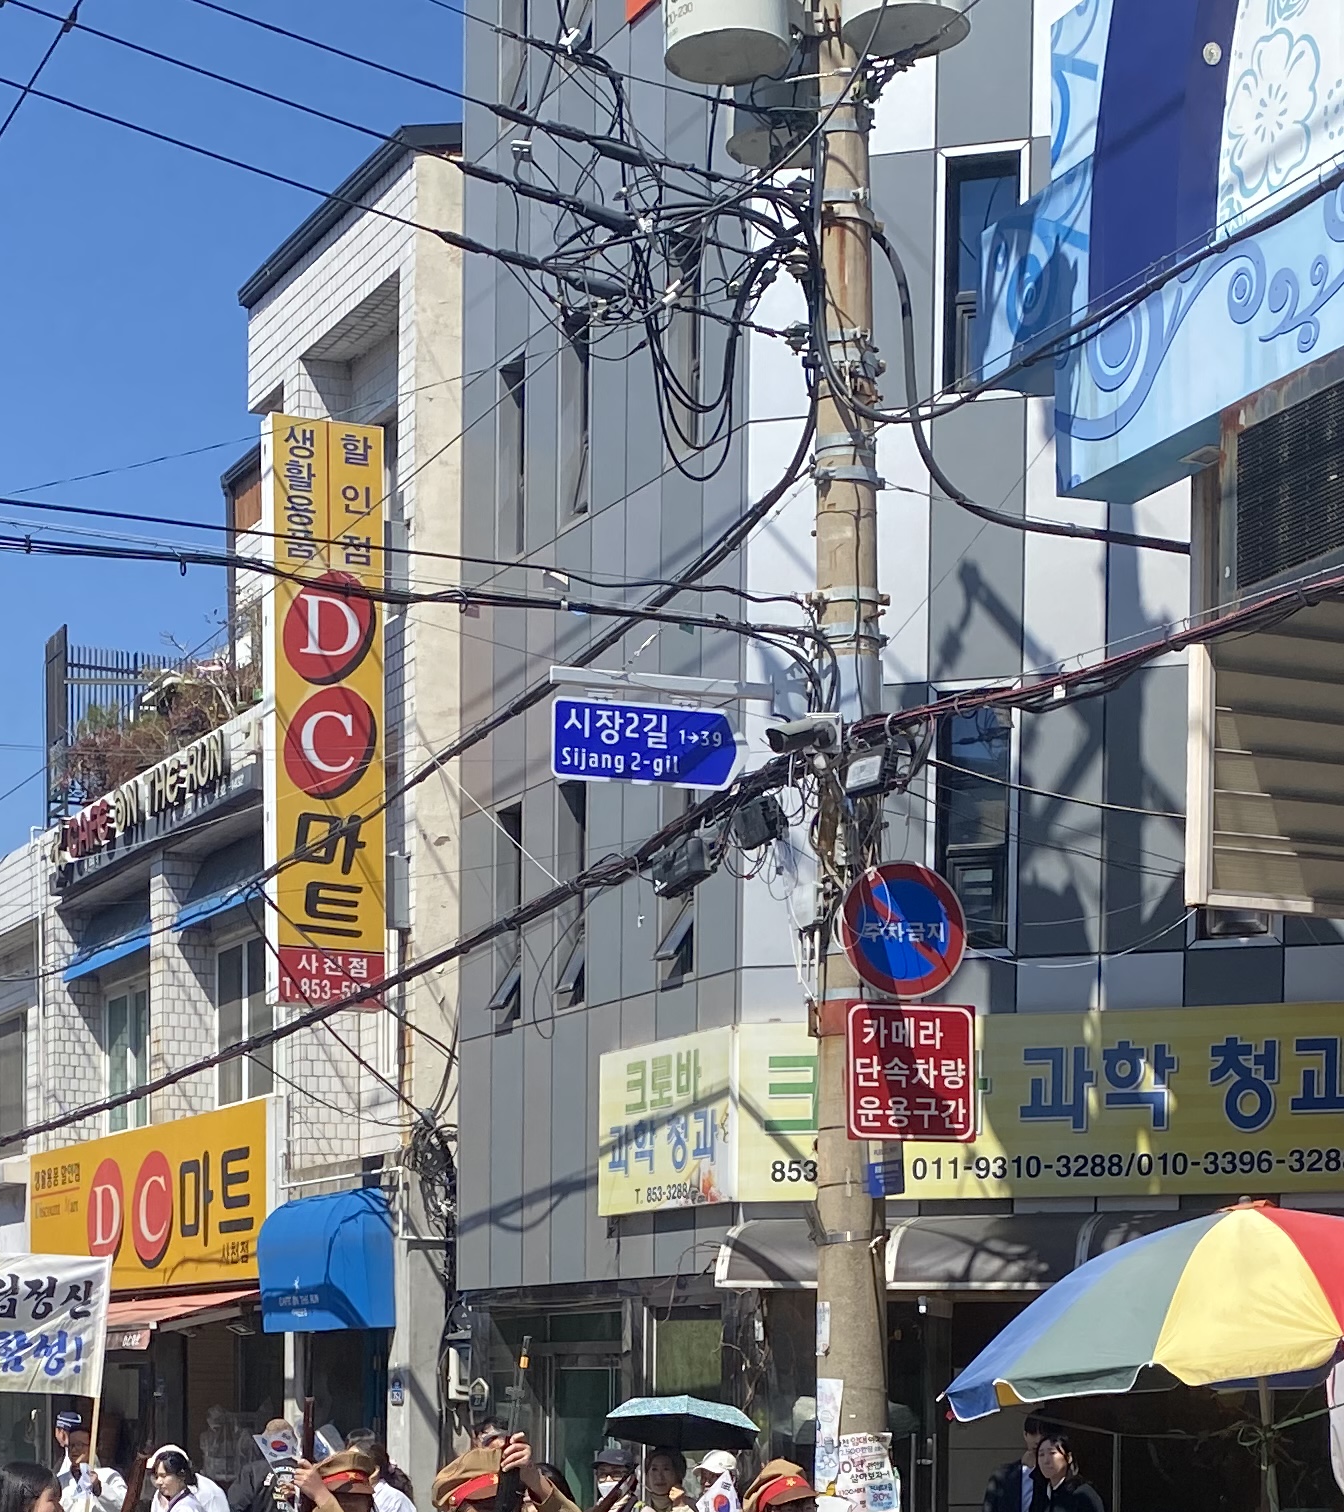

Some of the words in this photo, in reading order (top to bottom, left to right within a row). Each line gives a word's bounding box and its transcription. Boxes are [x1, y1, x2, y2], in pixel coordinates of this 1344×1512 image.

[284, 426, 317, 561] 생활용품
[340, 434, 373, 566] 할인점
[564, 708, 668, 750] 시장2길
[187, 729, 224, 795] RUN
[561, 747, 625, 774] Sijang
[630, 752, 680, 777] 2-gil
[864, 921, 946, 944] 주차금지
[296, 954, 368, 978] 사천점
[282, 976, 383, 1000] T.853-50
[862, 1016, 944, 1050] 카메라
[625, 1048, 703, 1115] 크로바
[856, 1055, 967, 1090] 단속차량
[1018, 1037, 1179, 1134] 과학
[856, 1097, 967, 1130] 운용구간
[607, 1119, 656, 1178] 과학
[666, 1108, 718, 1174] 청과
[221, 1240, 249, 1264] 사천점
